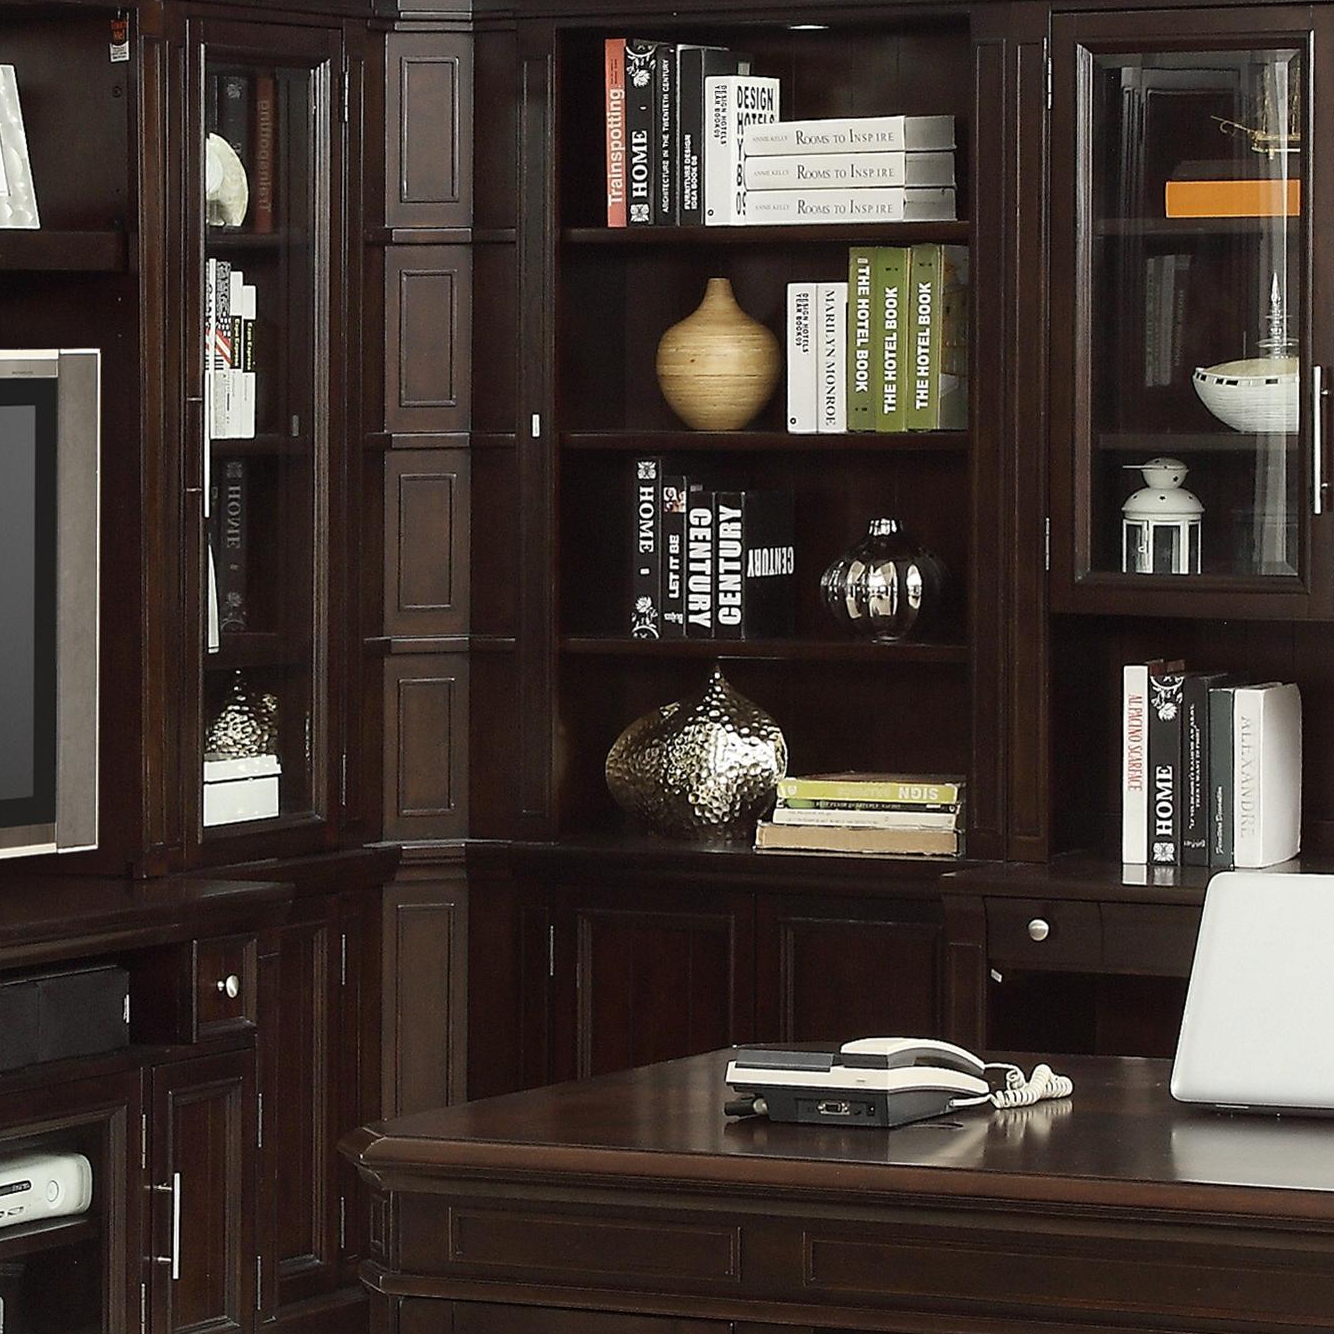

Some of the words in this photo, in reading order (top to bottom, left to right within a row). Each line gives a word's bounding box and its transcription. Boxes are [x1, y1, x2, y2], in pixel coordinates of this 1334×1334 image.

[737, 85, 774, 111] DESIGN
[607, 87, 626, 207] Trainspotting
[796, 130, 829, 145] ROOMS
[849, 128, 895, 143] INSPIRE
[631, 130, 648, 198] HOME
[797, 164, 831, 179] ROOMS
[850, 163, 895, 178] INSPIRE
[797, 199, 831, 214] ROOMS
[850, 199, 893, 214] INSPIRE
[857, 265, 871, 296] THE
[825, 290, 836, 358] MARILYN
[856, 299, 870, 347] HOTEL
[885, 286, 898, 329] BOOK
[918, 282, 932, 325] BOOK
[856, 349, 869, 393] BOOK
[884, 332, 897, 381] HOTEL
[917, 328, 930, 377] HOTEL
[825, 361, 836, 427] MONROE
[884, 383, 896, 414] THE
[916, 379, 929, 410] THE
[639, 486, 655, 553] HOME
[669, 534, 680, 554] BE
[669, 556, 680, 570] IT
[718, 505, 742, 626] CENTURY
[747, 546, 794, 578] CENTURY
[669, 571, 680, 599] LET
[688, 508, 713, 628] CENTURY
[1128, 708, 1143, 742] PACINO
[1128, 745, 1143, 792] SCARFACE
[1241, 715, 1256, 839] ALEXANDRE
[898, 786, 939, 800] SIGN
[1156, 765, 1173, 837] HOME
